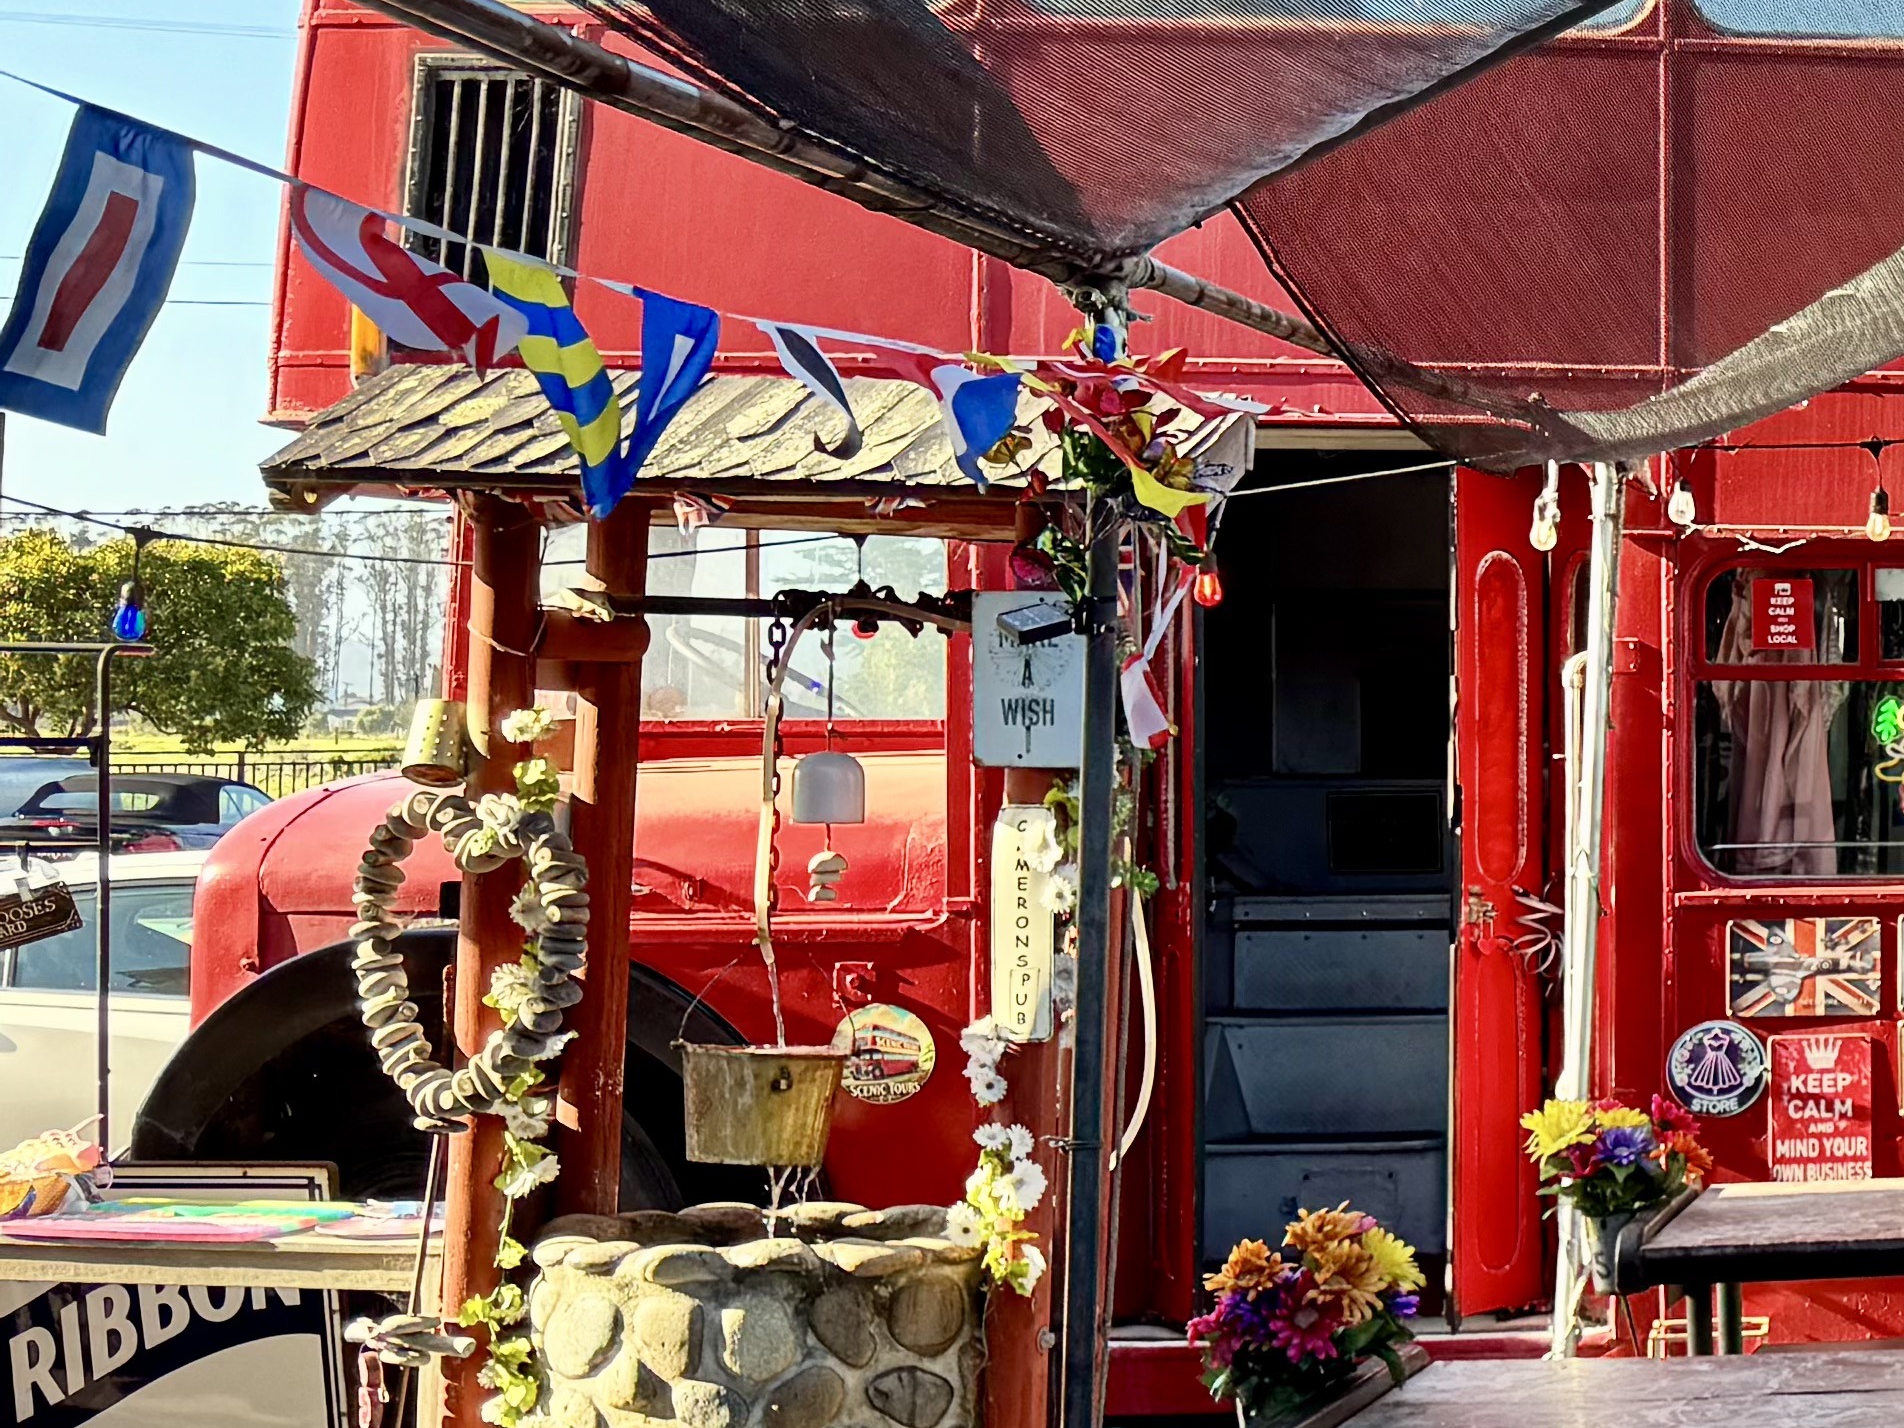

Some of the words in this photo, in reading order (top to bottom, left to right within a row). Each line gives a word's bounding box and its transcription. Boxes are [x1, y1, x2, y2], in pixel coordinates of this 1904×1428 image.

[1768, 607, 1795, 615] CALM
[1770, 597, 1795, 605] KEEP
[1767, 635, 1798, 643] LOCAL
[1001, 698, 1055, 727] WISH
[1014, 819, 1031, 968] CMERONS
[1015, 972, 1028, 1025] PUB
[850, 1083, 887, 1098] SCENIC
[889, 1081, 920, 1095] TOURS
[1790, 1073, 1851, 1094] KEEP
[1690, 1097, 1739, 1114] STORE
[1788, 1098, 1853, 1121] CALM
[1808, 1122, 1835, 1133] AND
[1776, 1138, 1819, 1158] MIND
[1823, 1136, 1868, 1157] YOUR
[1773, 1164, 1806, 1182] OWN
[1807, 1161, 1873, 1181] BUSINESS
[9, 1284, 301, 1423] RIBB
